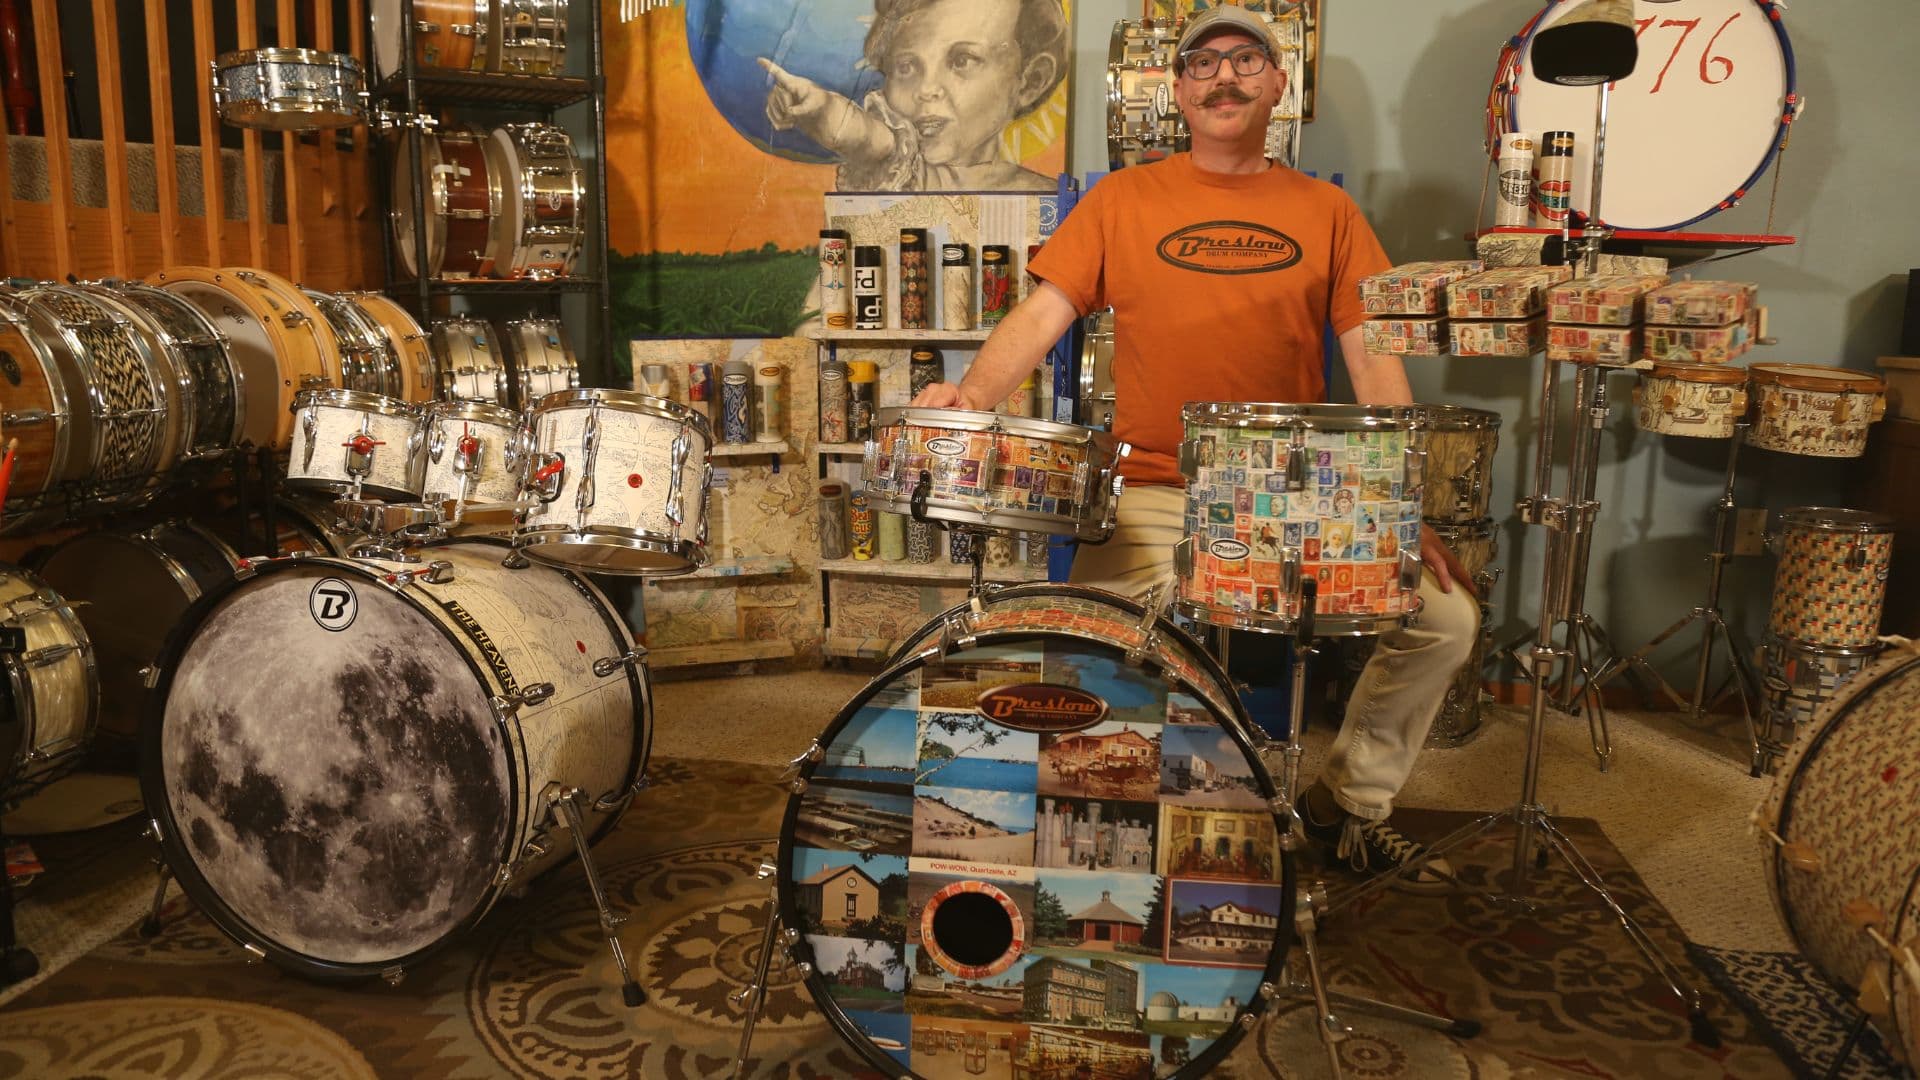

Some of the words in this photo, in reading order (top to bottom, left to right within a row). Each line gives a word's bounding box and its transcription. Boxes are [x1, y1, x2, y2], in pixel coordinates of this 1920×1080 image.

[1176, 234, 1287, 257] Breslow
[317, 588, 351, 619] B
[450, 603, 478, 628] THE
[474, 630, 520, 696] HEAVENS
[991, 694, 1098, 718] Breslow
